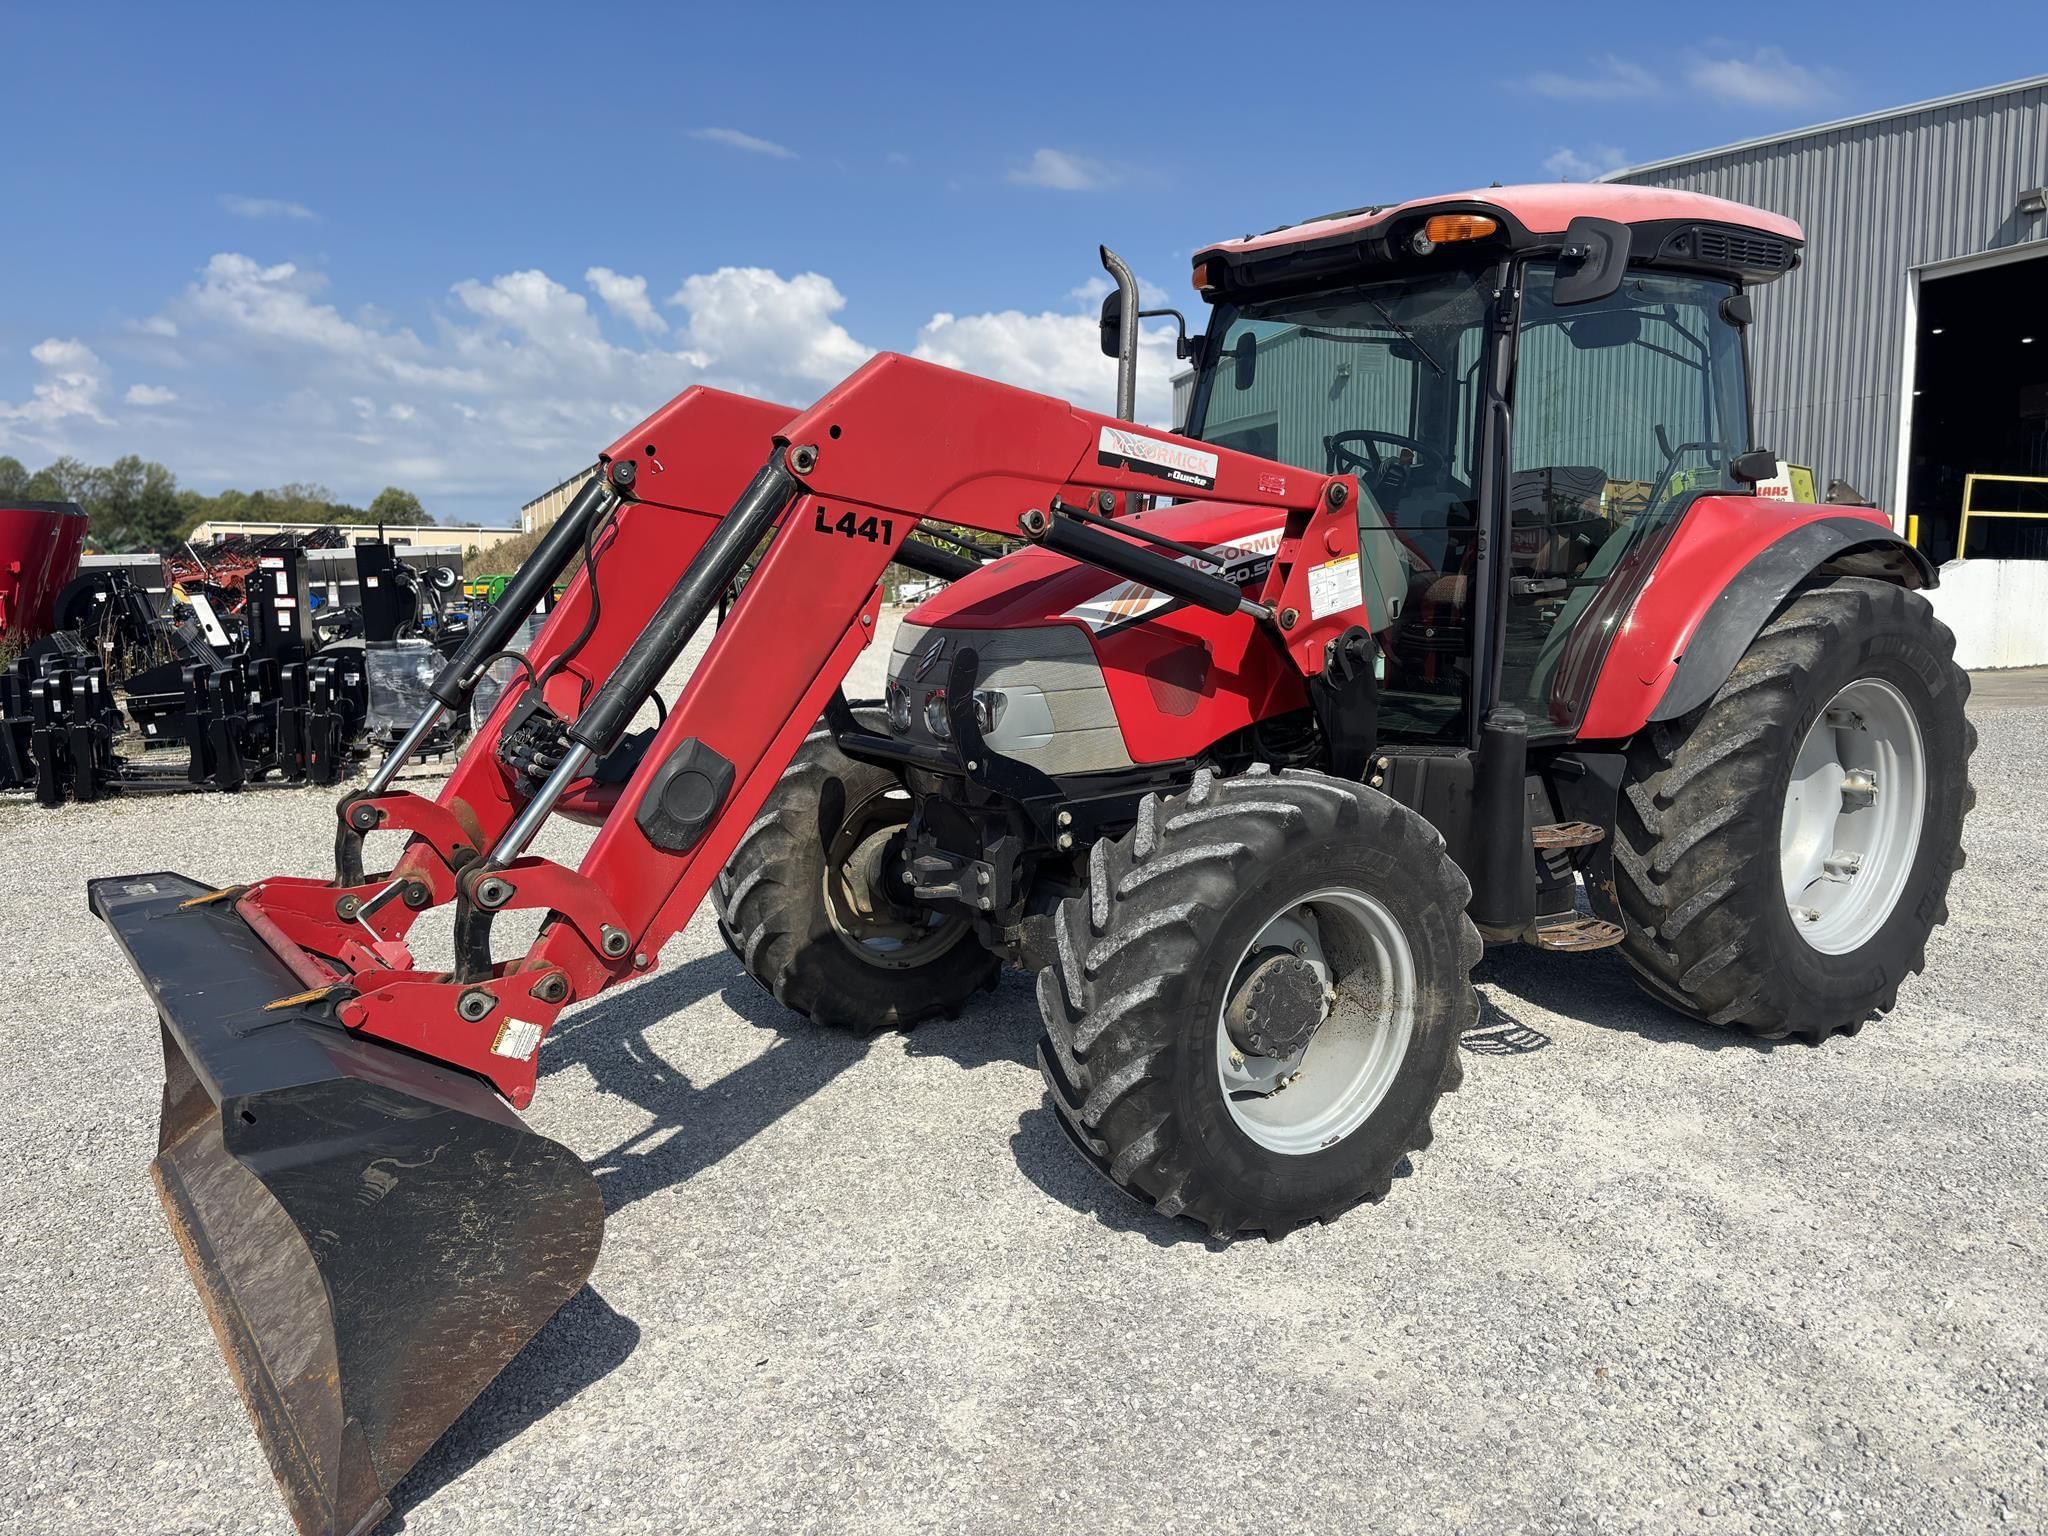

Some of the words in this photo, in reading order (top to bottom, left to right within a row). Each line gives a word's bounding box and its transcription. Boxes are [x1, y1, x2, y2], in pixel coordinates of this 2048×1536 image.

[1173, 470, 1207, 487] Quicke
[1757, 486, 1789, 497] LAAS
[815, 505, 893, 546] L441
